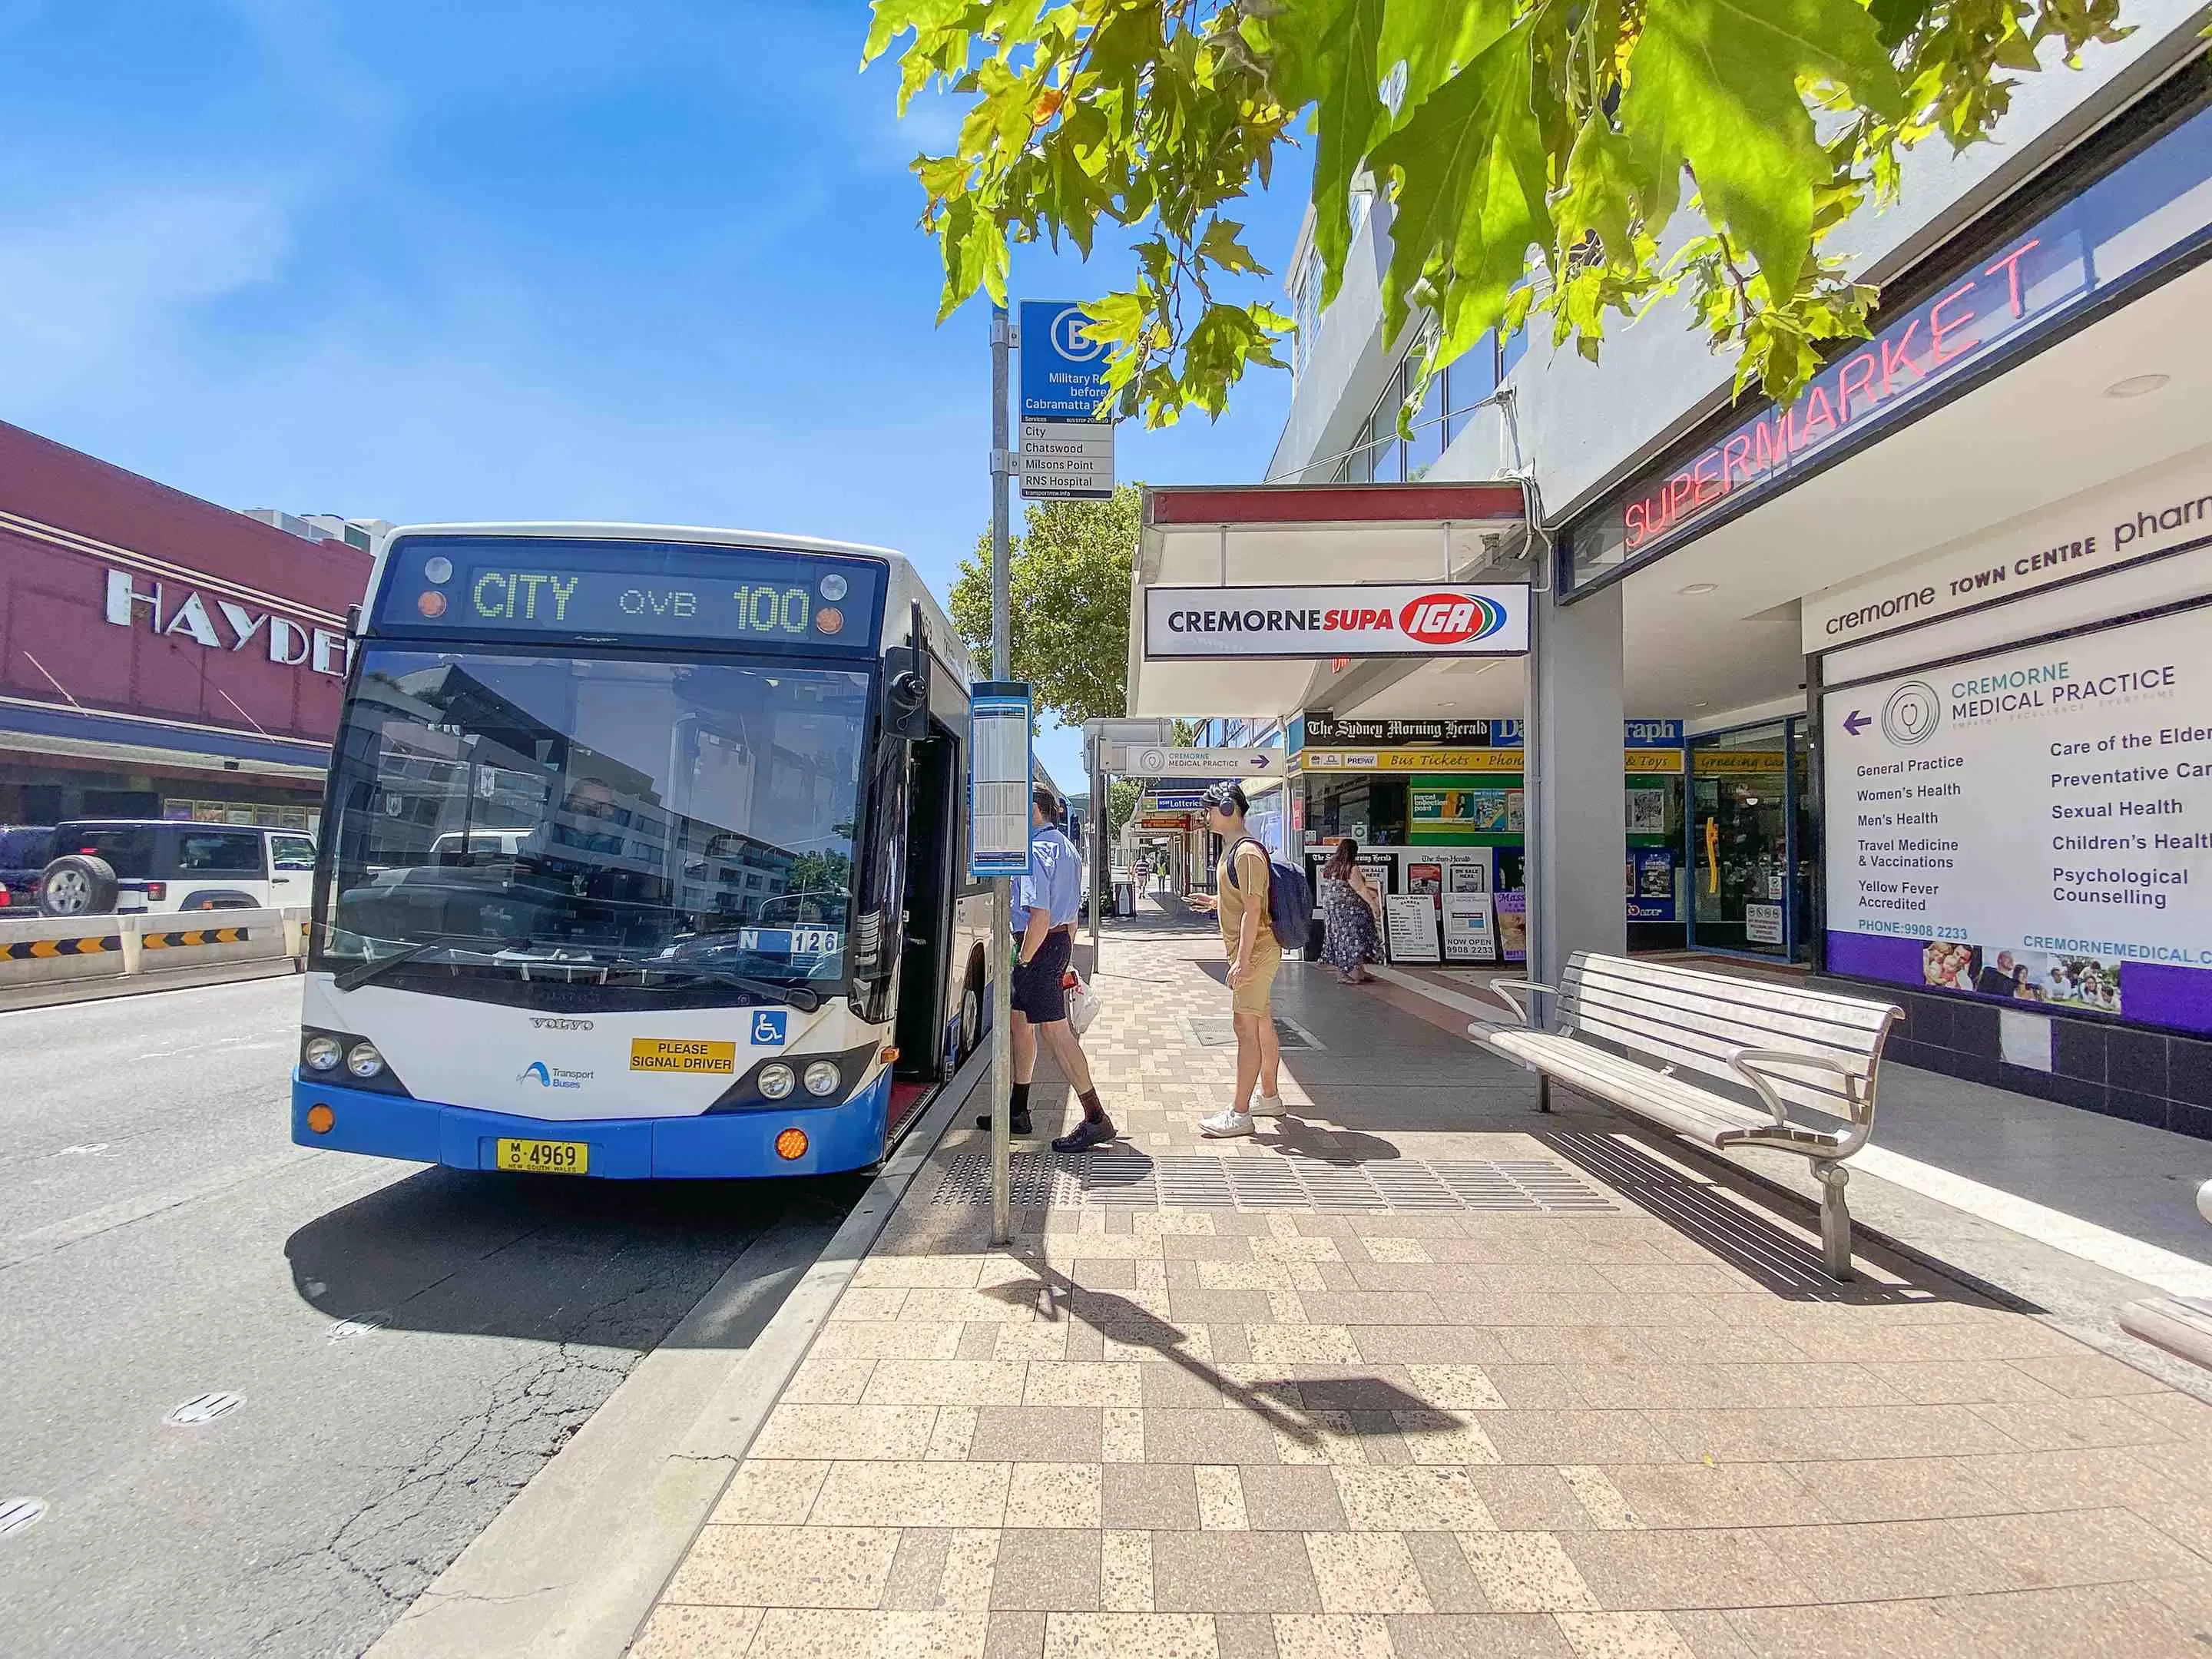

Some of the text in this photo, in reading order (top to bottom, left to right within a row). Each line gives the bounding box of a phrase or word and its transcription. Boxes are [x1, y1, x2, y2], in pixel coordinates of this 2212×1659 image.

[1068, 320, 1091, 349] B
[1049, 373, 1090, 386] Military
[1071, 386, 1107, 396] before
[1624, 239, 2040, 548] SUPERMARKET
[1025, 399, 1091, 410] Cabramatta
[1026, 427, 1045, 438] City
[1026, 443, 1083, 453] Chatswood
[1026, 459, 1093, 470] Milsons Point
[1026, 476, 1092, 488] RNS Hospital
[1826, 586, 1936, 635] cremorne
[1949, 565, 2006, 597] TOWN
[2014, 536, 2097, 575] CENTRE
[473, 571, 810, 634] CITY QVB 100
[106, 568, 353, 679] HAYDE
[1952, 661, 2070, 698] CREMORNE
[1952, 665, 2176, 720] MEDICAL PRACTICE
[1307, 719, 1488, 739] The Sydney Morning Herald
[2050, 742, 2091, 757] Care
[2097, 736, 2115, 752] of
[2122, 733, 2152, 750] the
[1390, 750, 1525, 766] Bus Tickets Phon
[1640, 756, 1669, 770] Toys
[1701, 754, 1759, 768] Greeting
[1856, 756, 1965, 777] General Practice
[2051, 767, 2170, 788] Preventative
[1856, 783, 1961, 802] Women's Health
[2051, 798, 2184, 820] Sexual Health
[1857, 812, 1939, 826] Men's Health
[1858, 839, 1959, 851] Travel Medicine
[1858, 855, 1954, 868] & Vaccinations
[2053, 868, 2188, 887] Psychological
[1858, 880, 1939, 896] Yellow Fever
[1858, 896, 1926, 911] Accredited
[2053, 887, 2167, 909] Counselling
[740, 930, 759, 949] N
[1937, 928, 1969, 940] 2233
[529, 1017, 594, 1031] VOLVO
[658, 1043, 708, 1055] PLEASE
[632, 1056, 732, 1070] SIGNAL DRIVER
[552, 1068, 594, 1079] Transport
[552, 1079, 581, 1089] Buses
[529, 1144, 576, 1166] 4969
